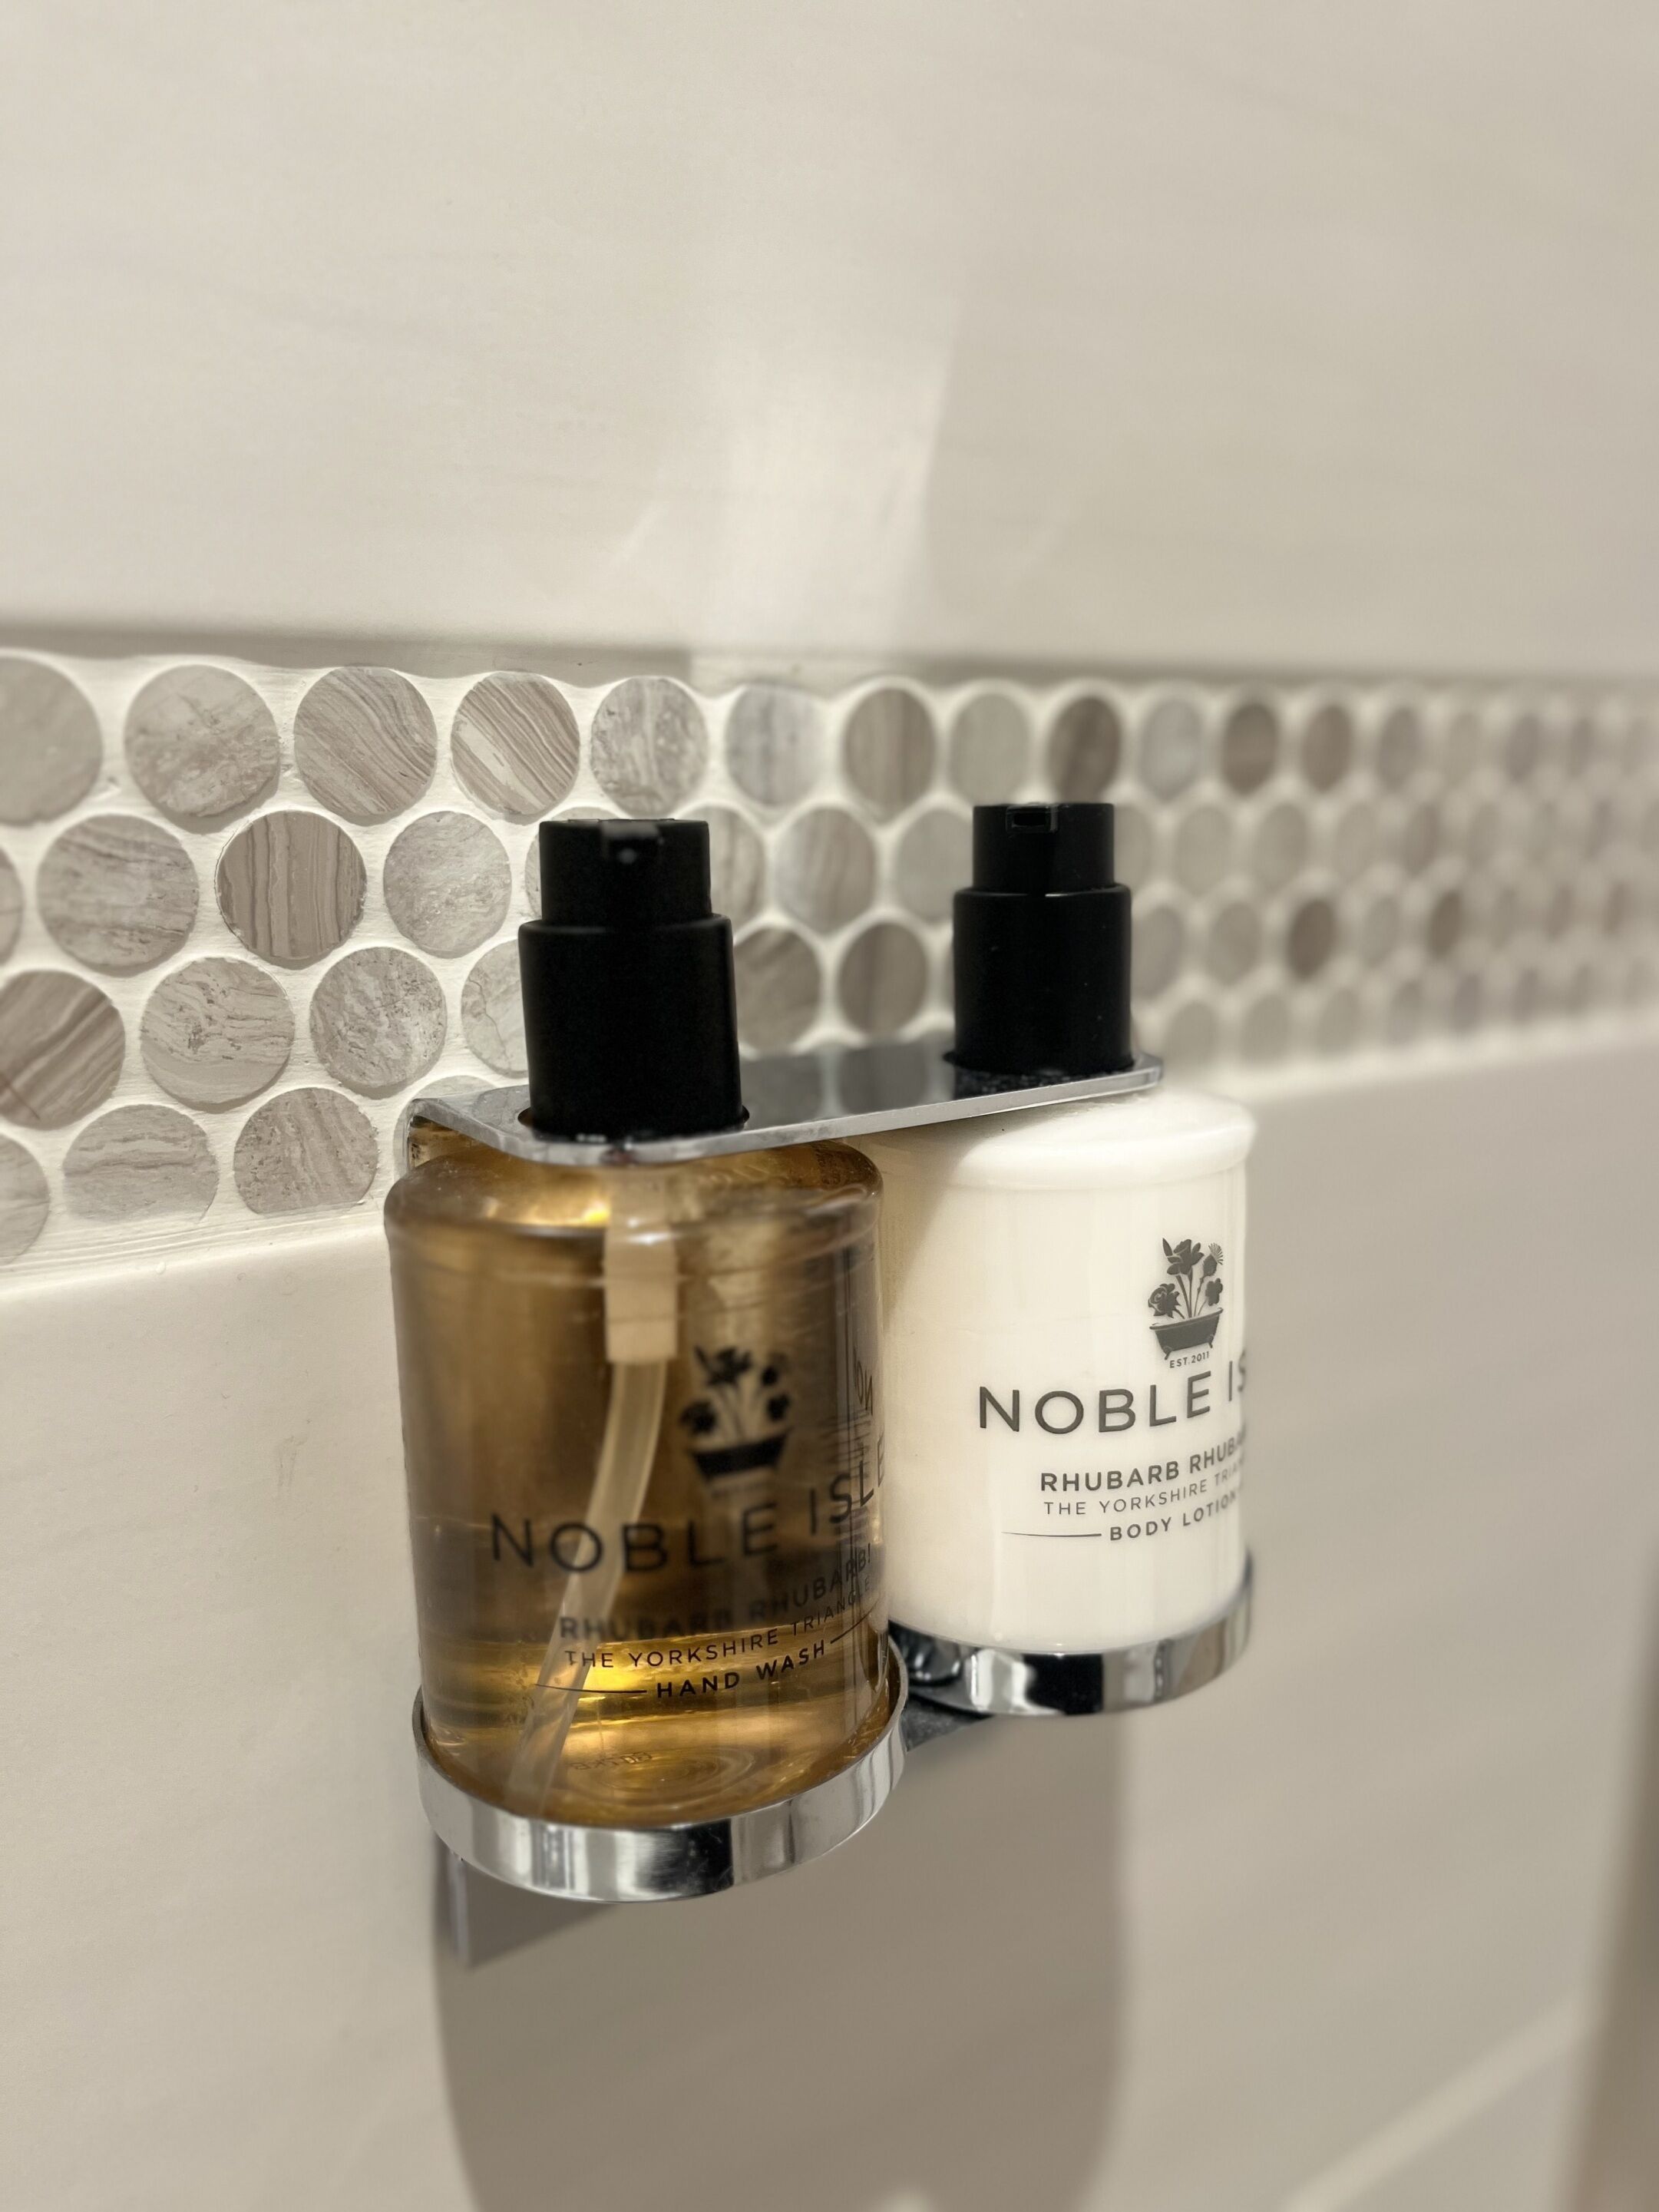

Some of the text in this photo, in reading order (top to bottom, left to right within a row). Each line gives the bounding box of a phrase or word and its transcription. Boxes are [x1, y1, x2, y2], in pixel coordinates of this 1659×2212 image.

[980, 1371, 1211, 1434] NOBLE
[491, 1502, 778, 1572] NOBLE
[808, 1430, 886, 1534] ISLE
[1041, 1460, 1180, 1492] RHUBARB
[1043, 1501, 1087, 1515] THE
[1099, 1478, 1208, 1514] YORKSHIRE
[1110, 1490, 1237, 1541] BODY LOTION
[564, 1577, 871, 1668] THE YORKSHIRE TRIANGLE
[657, 1639, 825, 1698] HAND WASH
